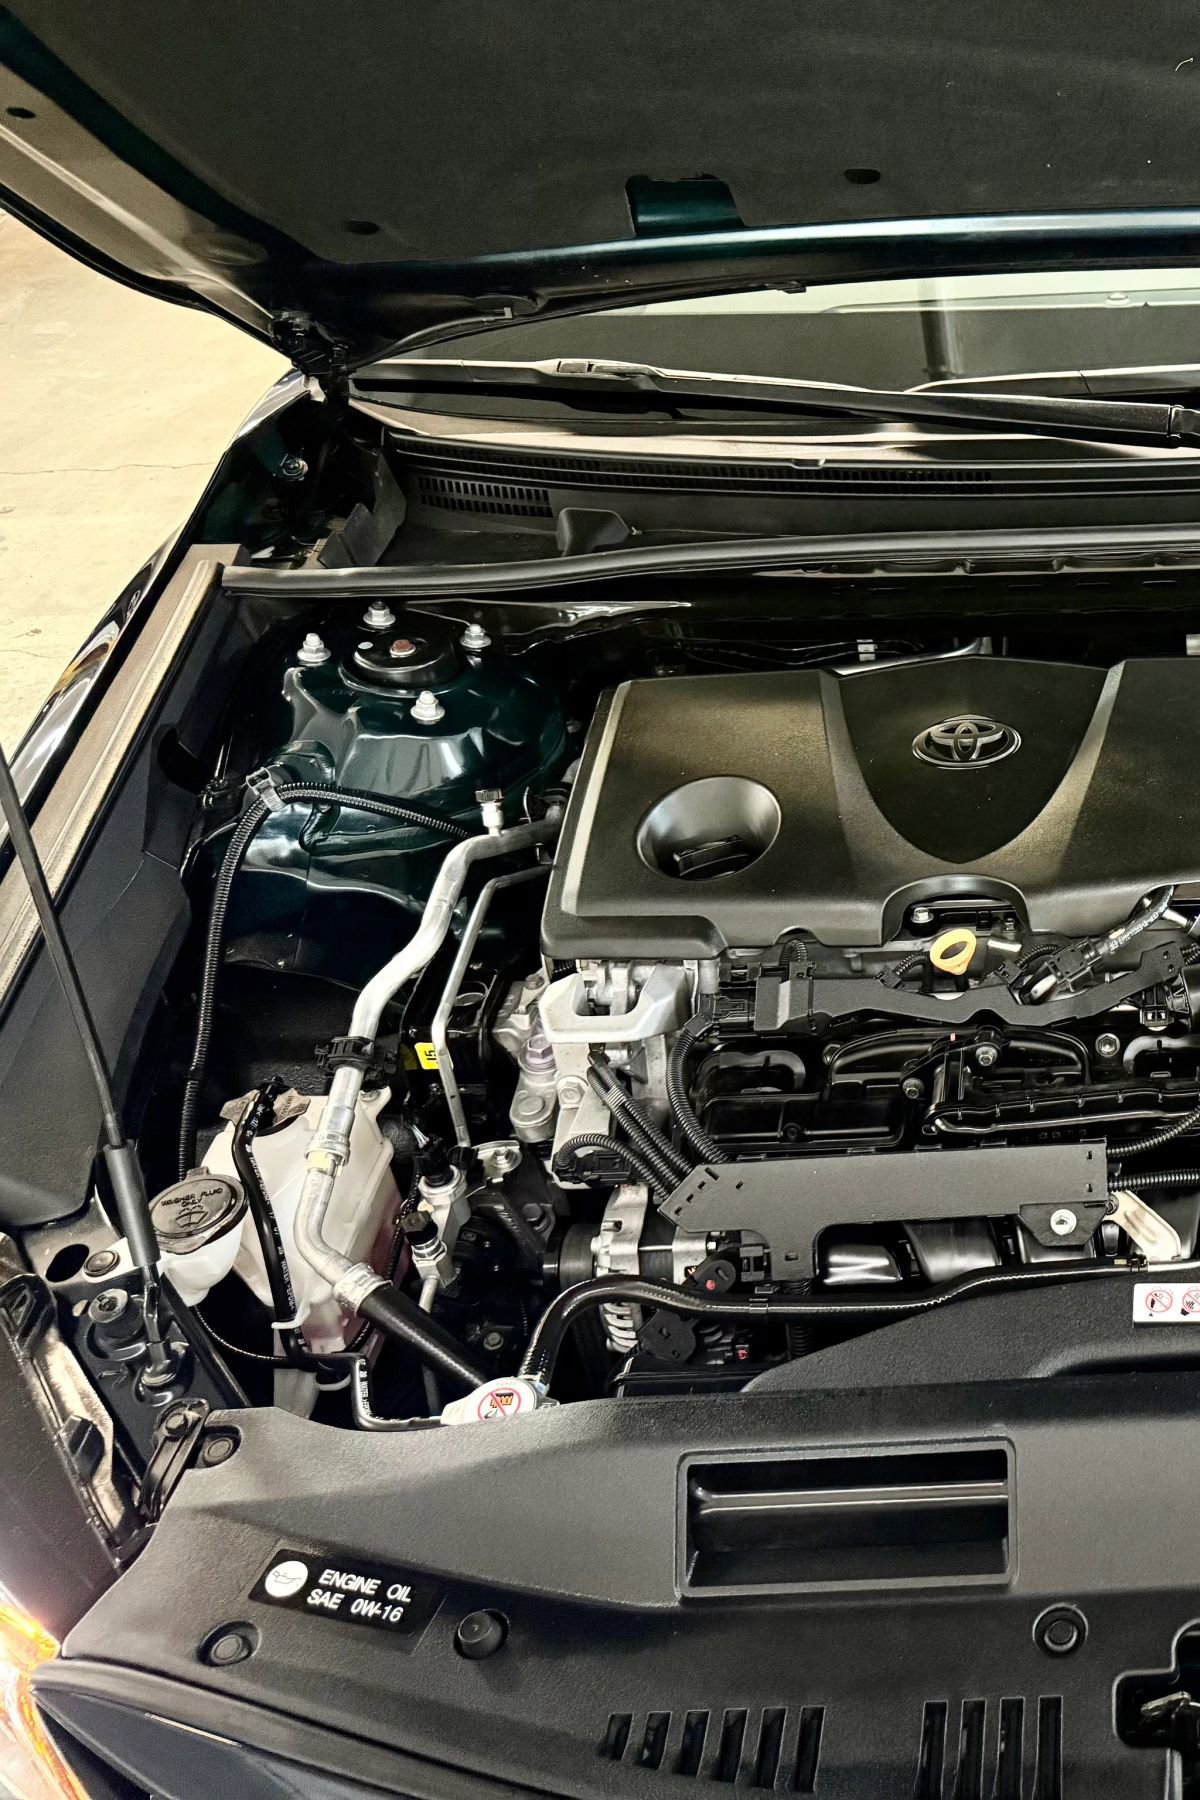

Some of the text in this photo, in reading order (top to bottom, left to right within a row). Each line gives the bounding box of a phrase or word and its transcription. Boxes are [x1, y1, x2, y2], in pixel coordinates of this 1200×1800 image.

[161, 1187, 223, 1206] WASHER FLUID
[181, 1198, 202, 1207] ONLY
[280, 1261, 290, 1284] WATER
[318, 1568, 411, 1603] ENGINE OIL
[307, 1588, 404, 1622] SAE 0W-16
